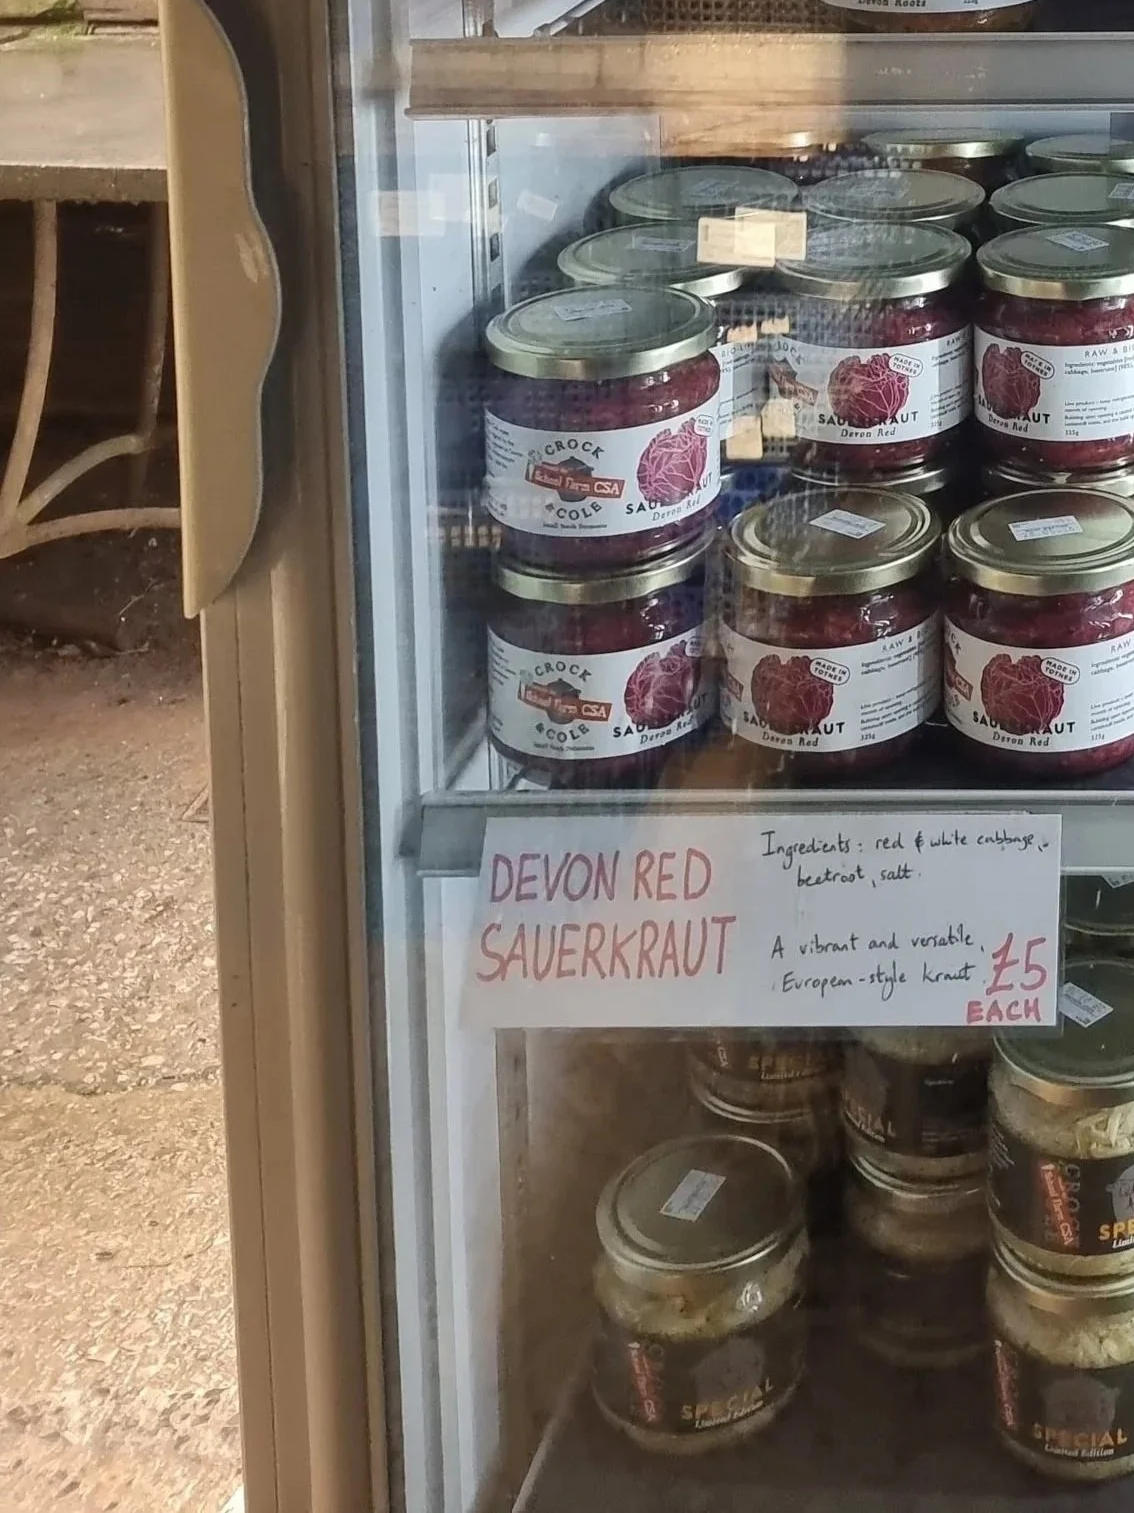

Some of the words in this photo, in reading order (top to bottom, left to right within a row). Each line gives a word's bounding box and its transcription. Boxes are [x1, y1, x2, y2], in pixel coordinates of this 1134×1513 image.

[1085, 349, 1108, 358] RAW
[544, 438, 605, 460] CROCK
[594, 481, 620, 495] CSA
[799, 737, 819, 747] Red
[1030, 737, 1049, 747] Red
[875, 832, 902, 851] red
[930, 830, 968, 848] white
[490, 850, 620, 903] DEVON
[633, 848, 712, 901] RED
[476, 915, 737, 982] SAUERKRAUT
[771, 936, 784, 959] A
[799, 934, 859, 955] vibrant
[868, 933, 900, 950] and
[985, 933, 1047, 996] £5
[966, 998, 1042, 1025] EACH
